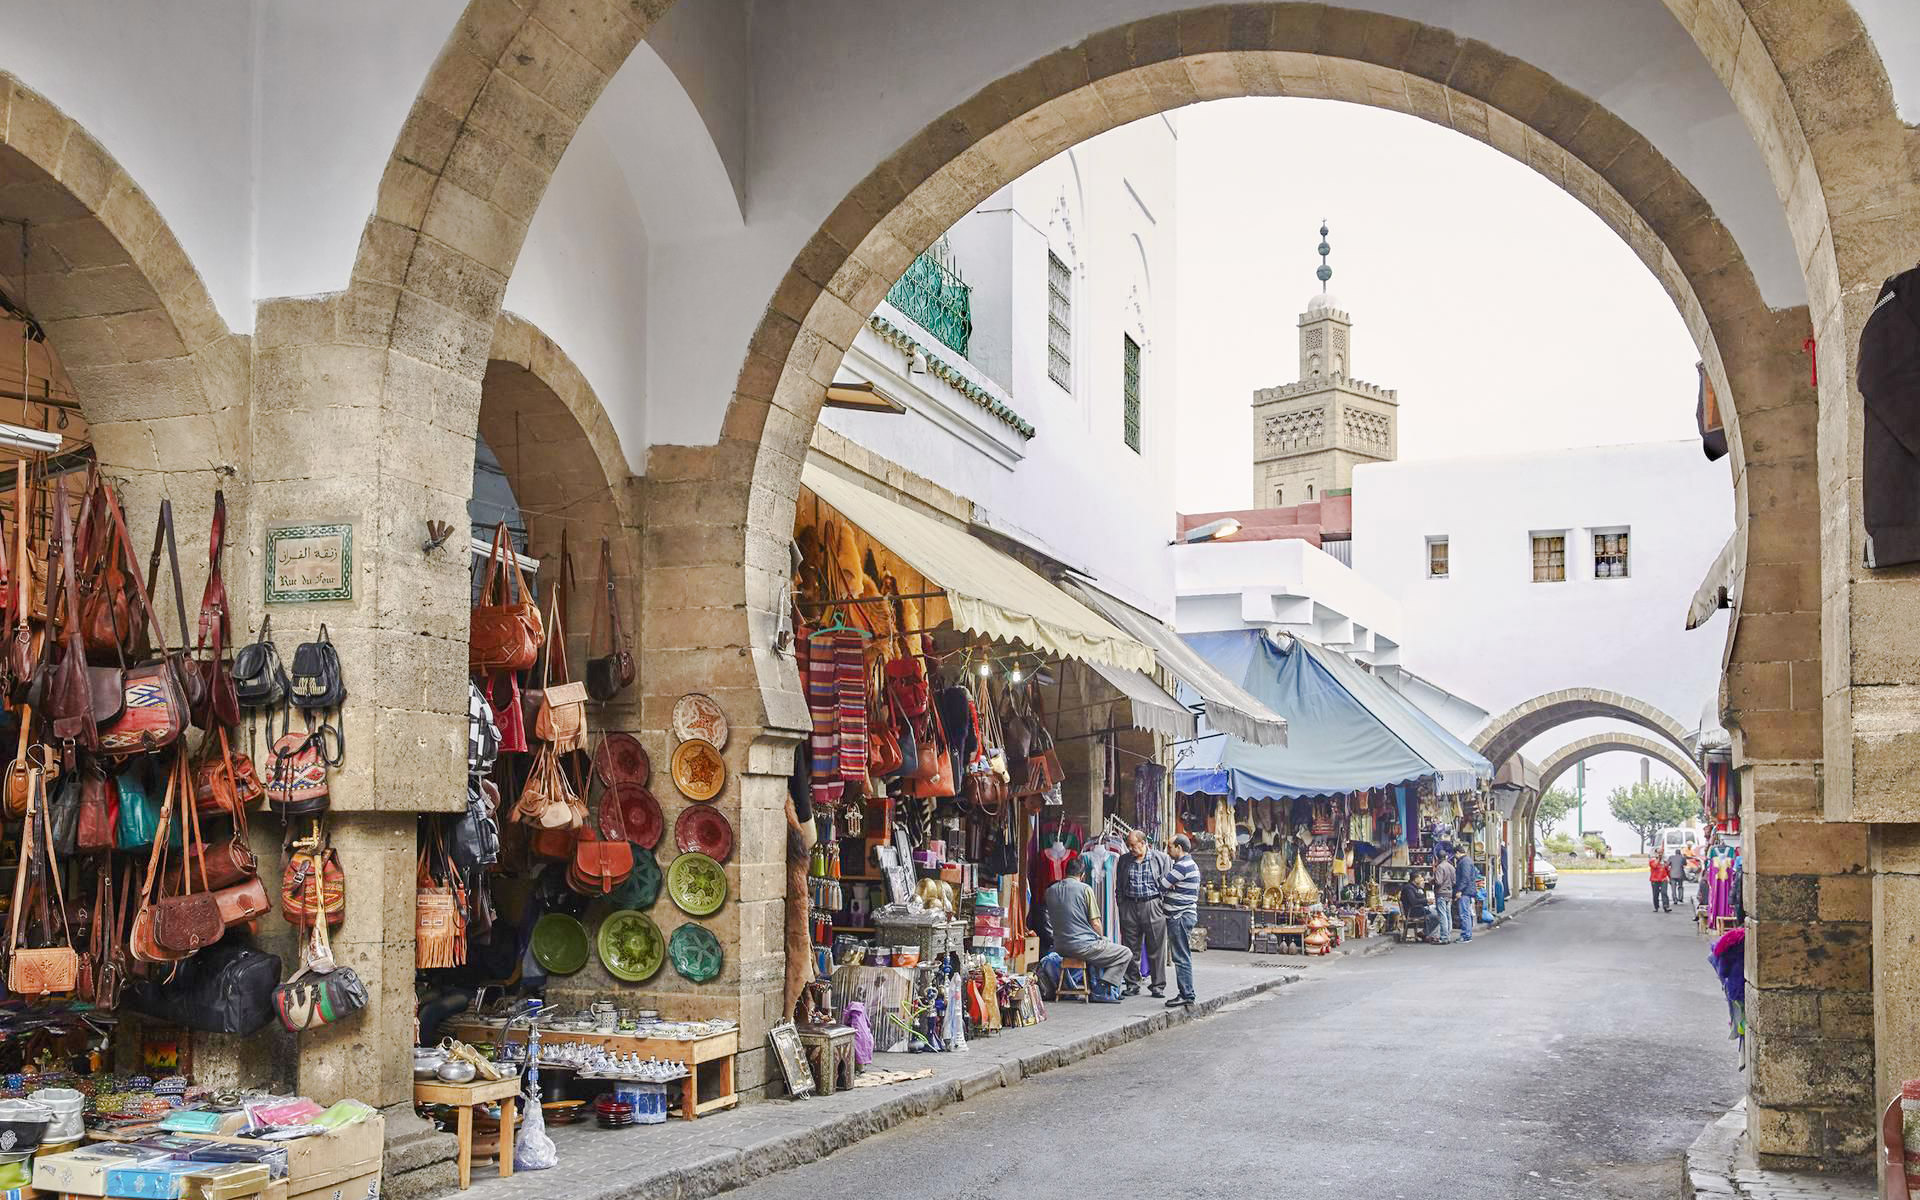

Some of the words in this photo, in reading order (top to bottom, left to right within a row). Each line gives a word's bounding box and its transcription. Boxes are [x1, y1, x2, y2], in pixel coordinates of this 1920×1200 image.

[278, 546, 311, 566] الفران
[314, 547, 338, 562] زنقة
[279, 575, 298, 587] Rue
[301, 573, 312, 585] du
[314, 572, 336, 584] Four
